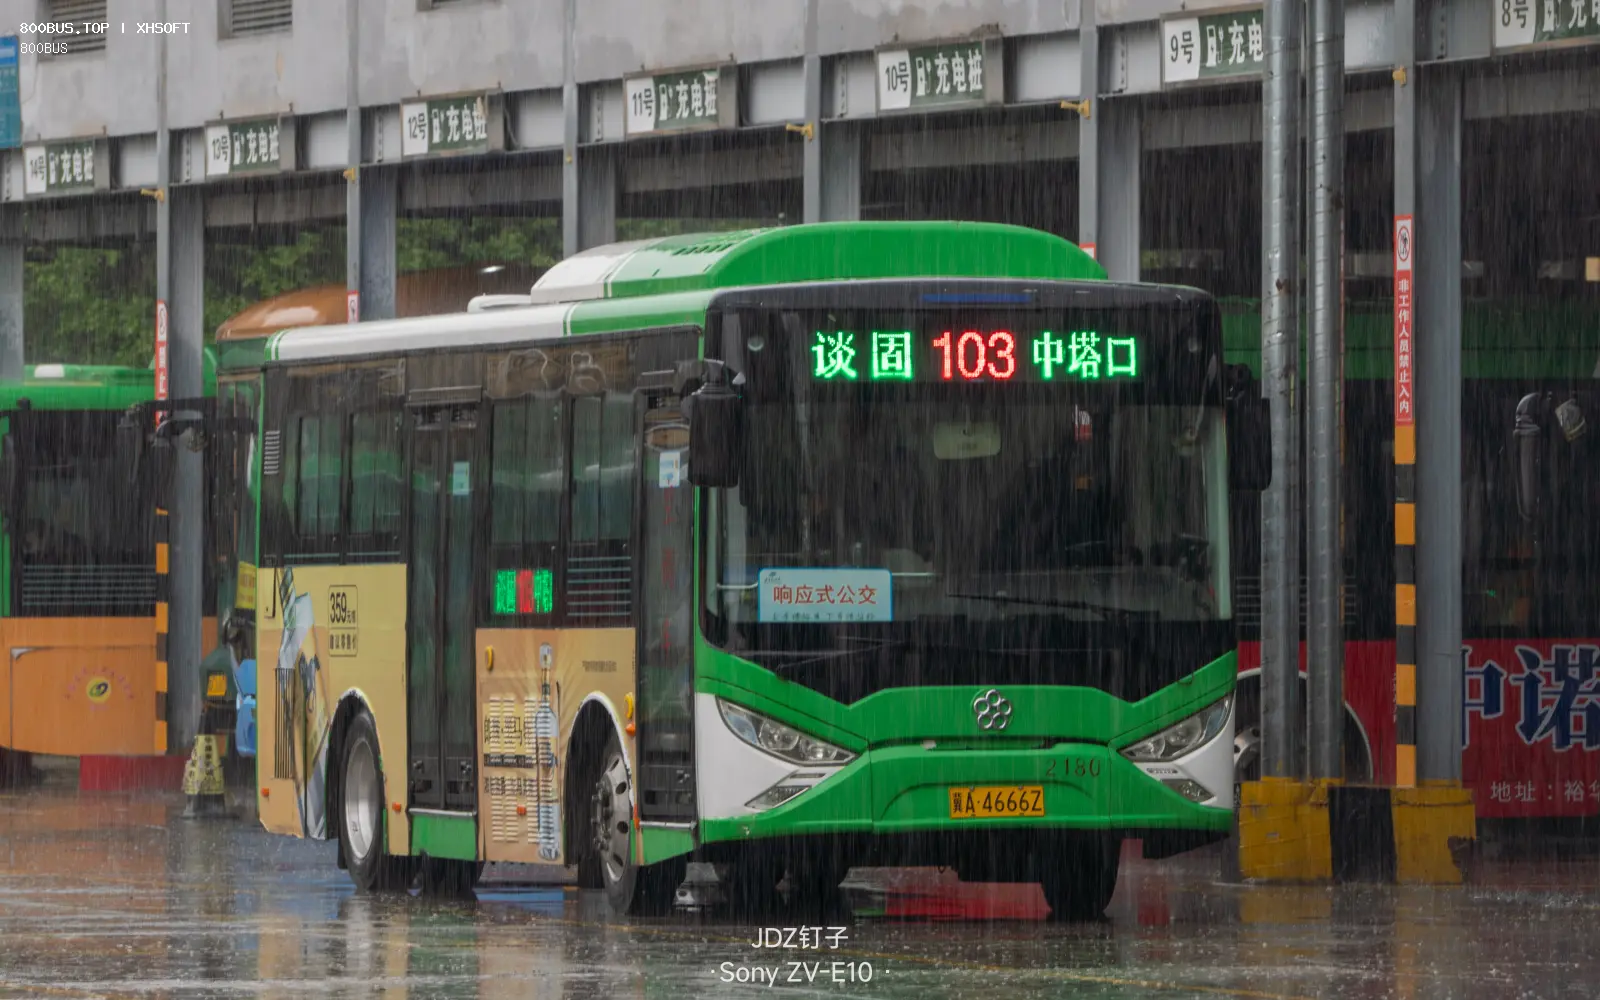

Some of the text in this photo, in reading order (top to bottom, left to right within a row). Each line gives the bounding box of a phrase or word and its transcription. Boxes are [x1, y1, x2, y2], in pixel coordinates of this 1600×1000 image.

[1568, 0, 1600, 29] 充
[1170, 17, 1263, 66] 9号 充电
[885, 48, 983, 95] 10号 充电桩
[632, 79, 718, 120] 11号 充电桩
[407, 101, 488, 143] 12号 充电桩
[211, 140, 230, 163] 13号
[812, 331, 1137, 379] 谈固 103 中塔口
[1398, 279, 1410, 414] 非工作人员禁止入内
[773, 584, 877, 605] 响应式公交
[1046, 757, 1101, 778] 2180
[953, 790, 1043, 814] 冀A·4666Z
